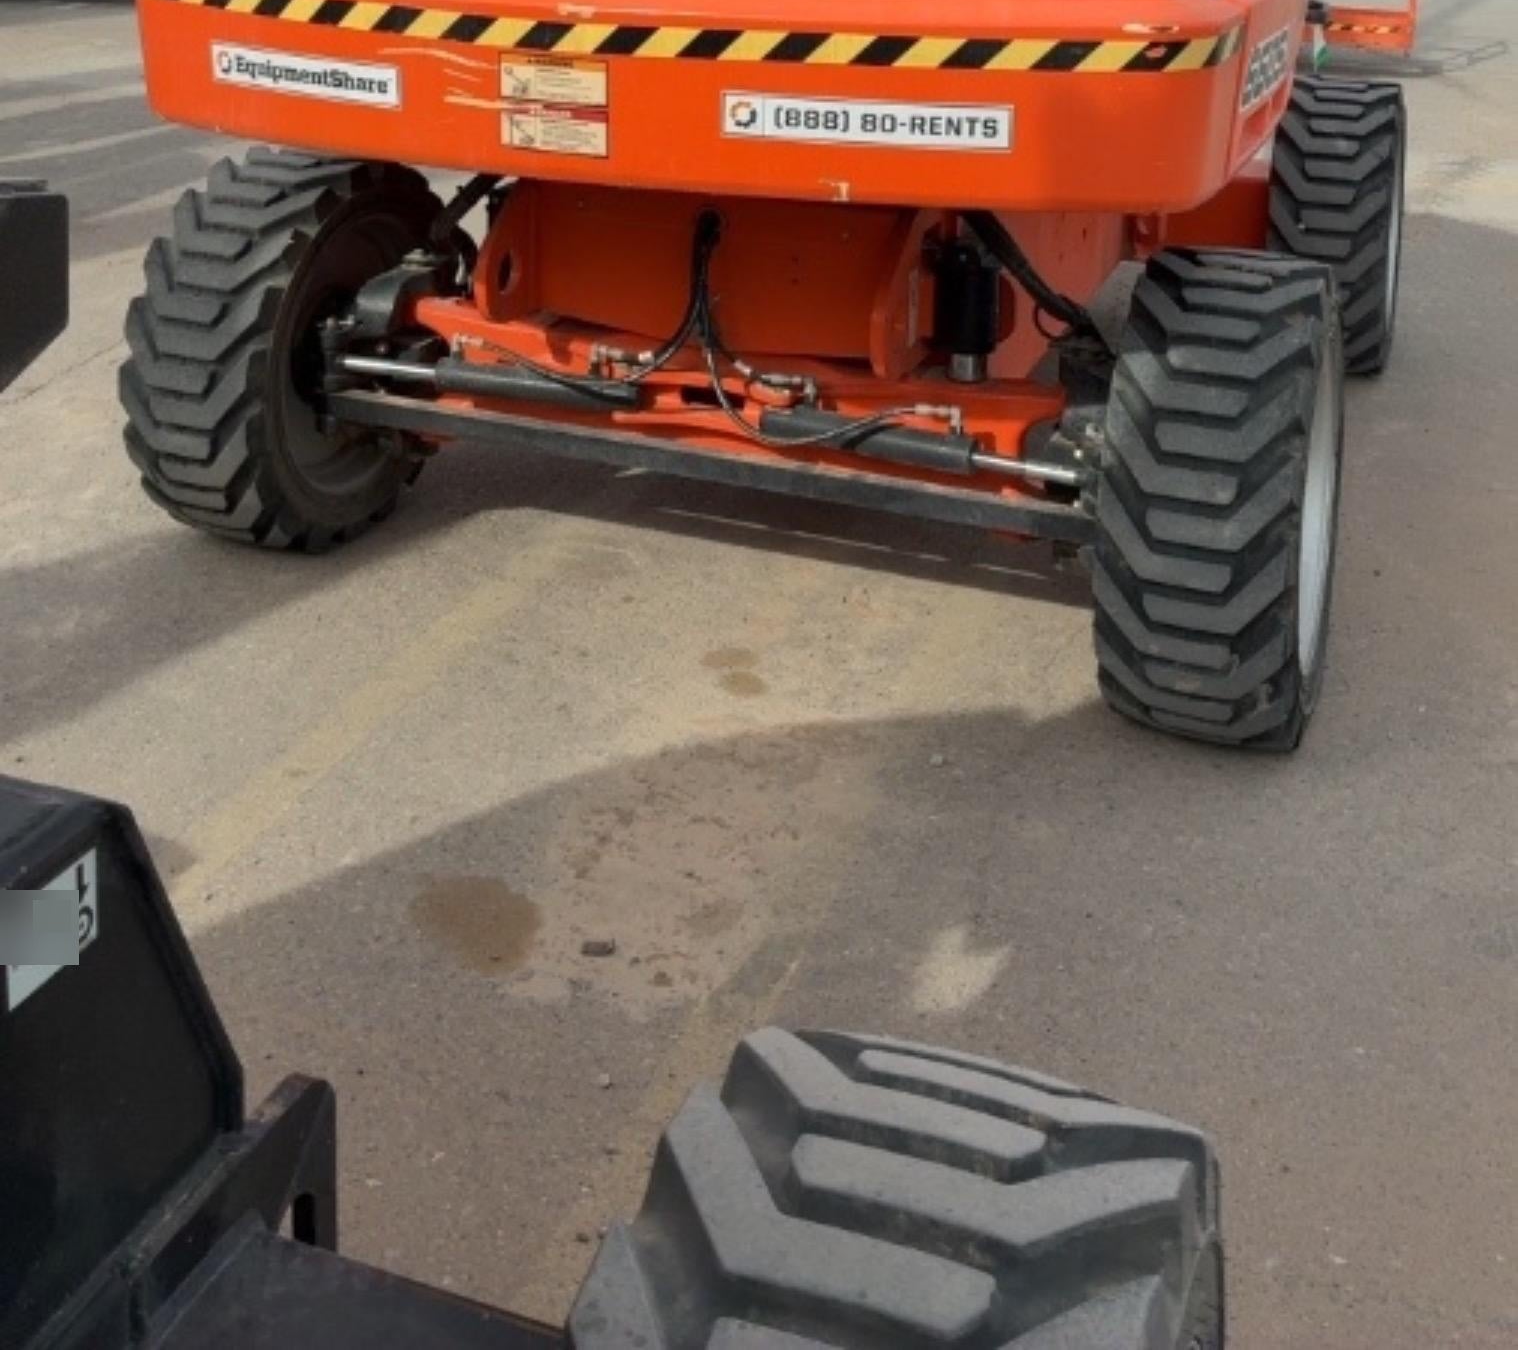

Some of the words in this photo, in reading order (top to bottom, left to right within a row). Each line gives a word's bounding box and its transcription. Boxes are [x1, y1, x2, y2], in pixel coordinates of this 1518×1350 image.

[234, 55, 389, 94] EquipmentShare
[773, 105, 850, 133] (888)
[860, 112, 999, 139] 80-RENTS
